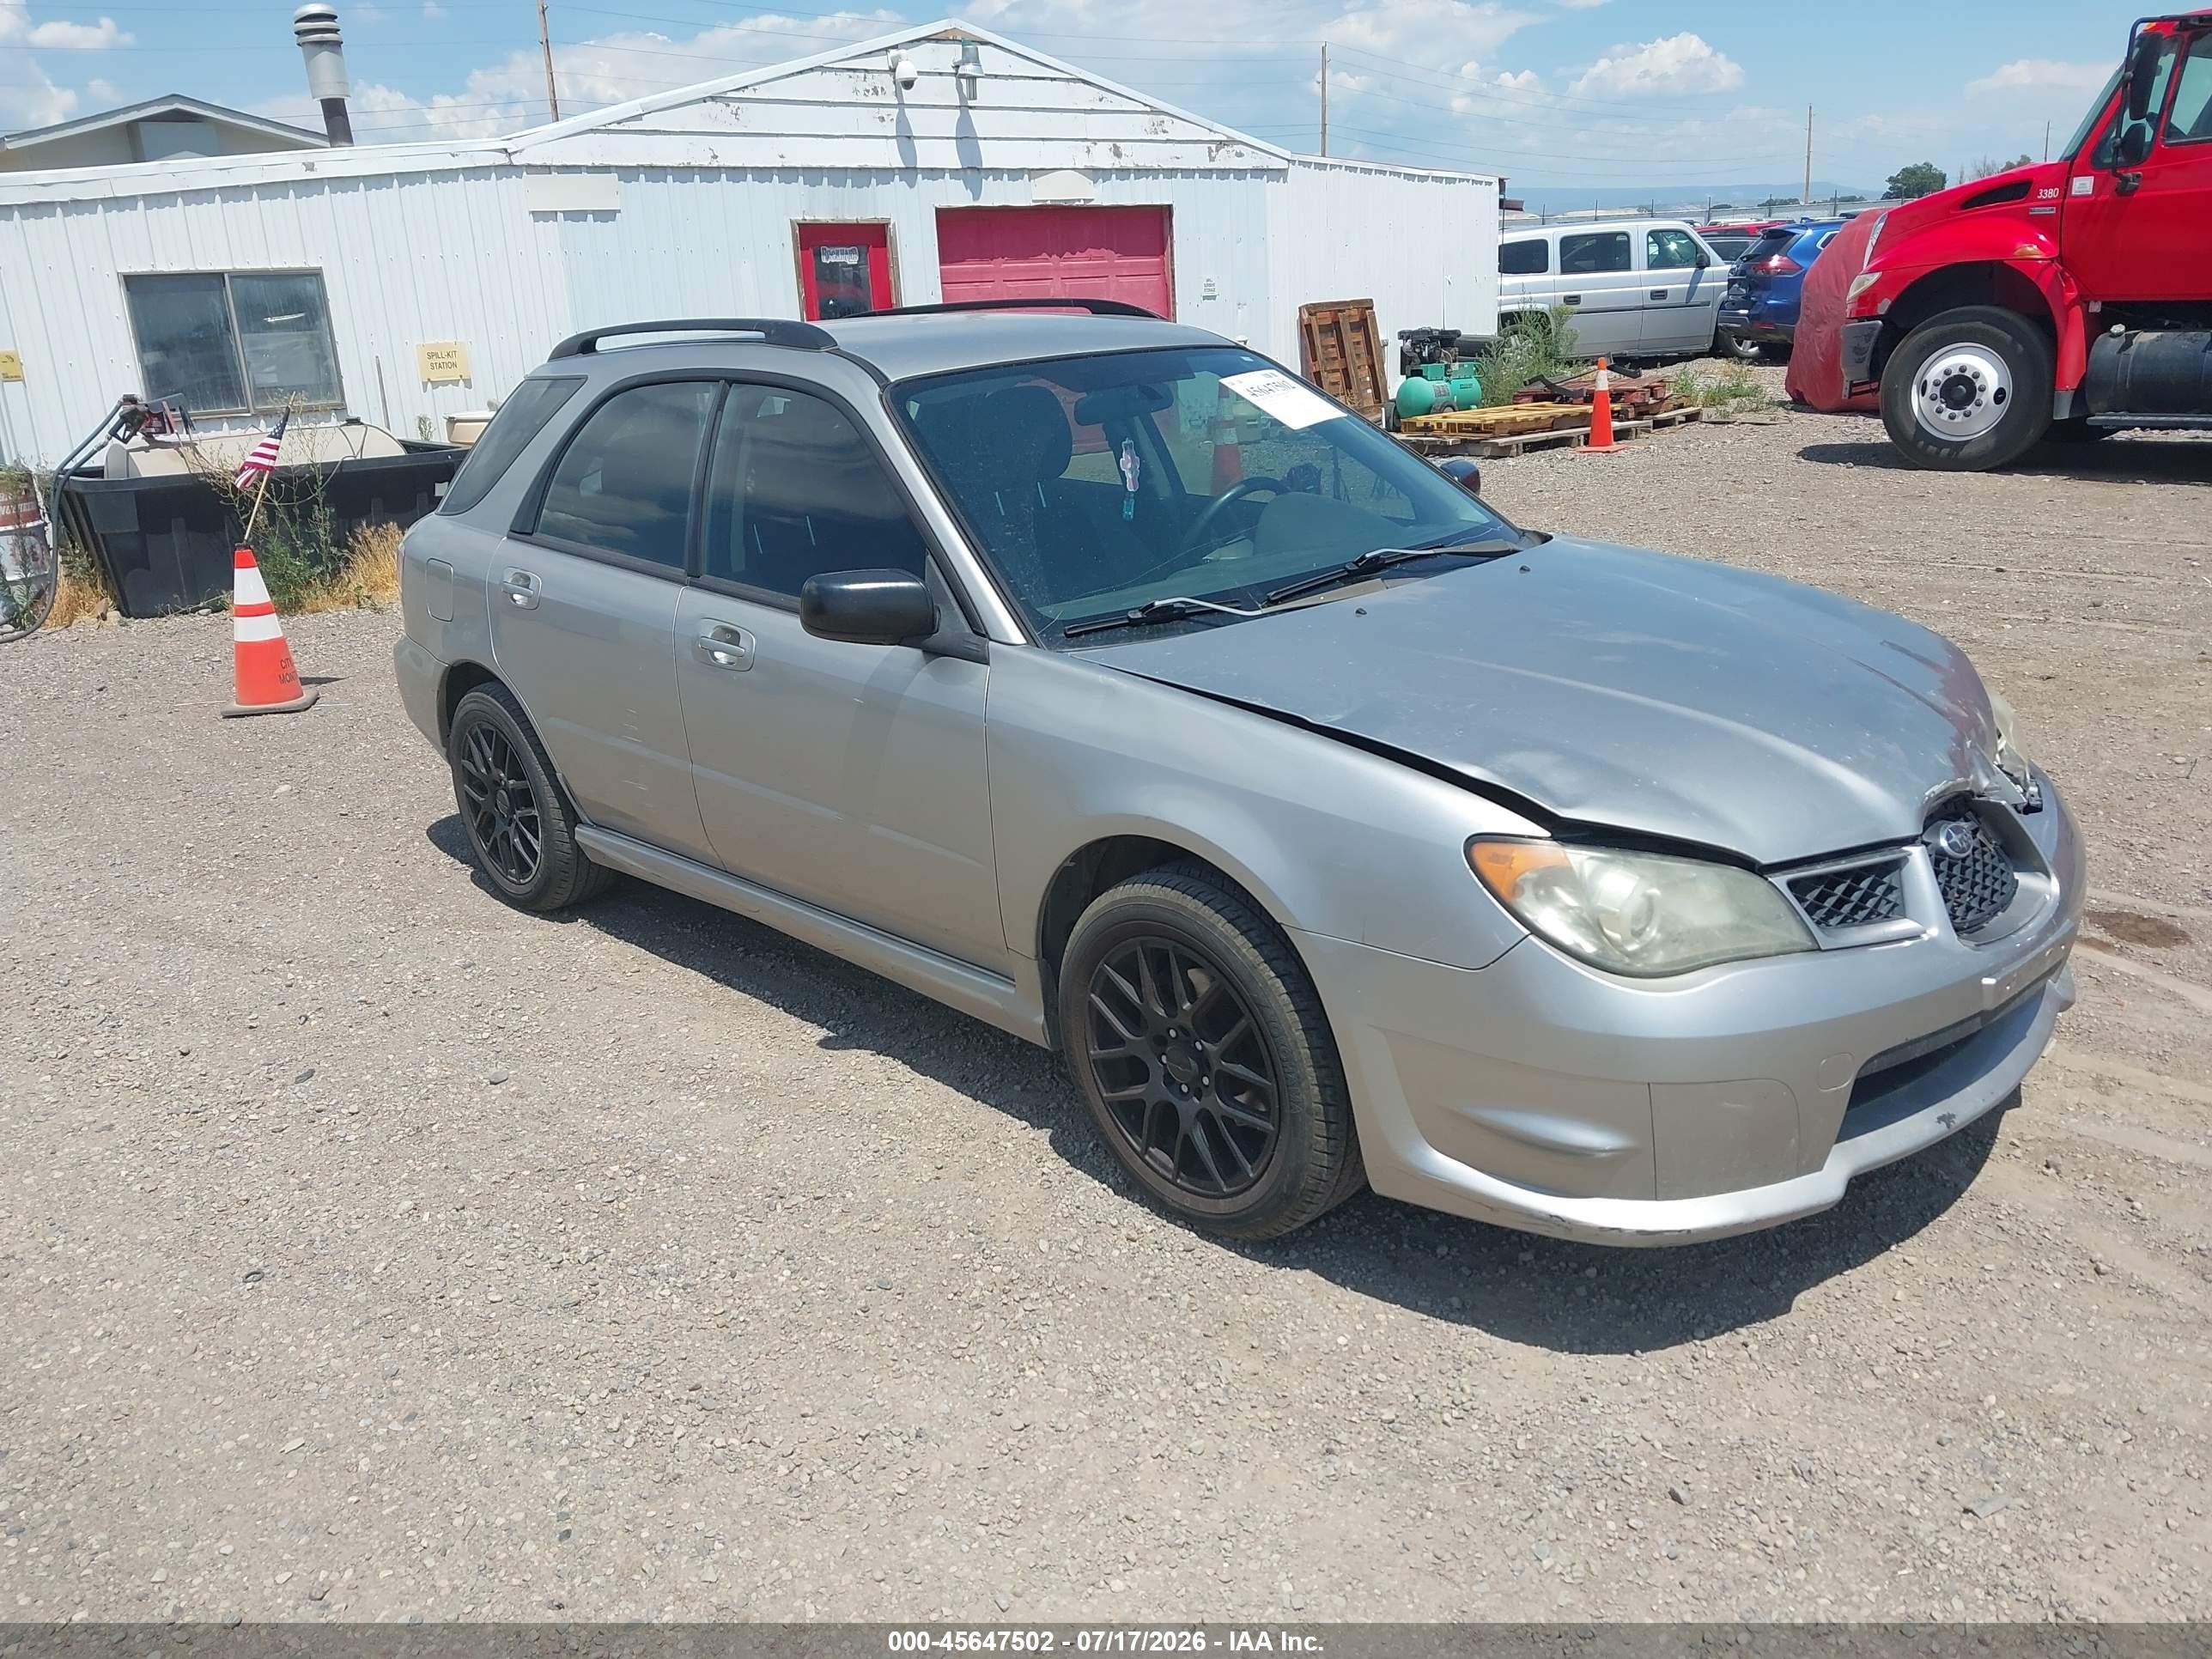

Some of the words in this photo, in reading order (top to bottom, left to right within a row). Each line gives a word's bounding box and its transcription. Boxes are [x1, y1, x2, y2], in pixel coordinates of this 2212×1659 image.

[2037, 187, 2059, 199] 3380
[426, 350, 458, 360] SPILL-KIT
[430, 361, 458, 370] STATION
